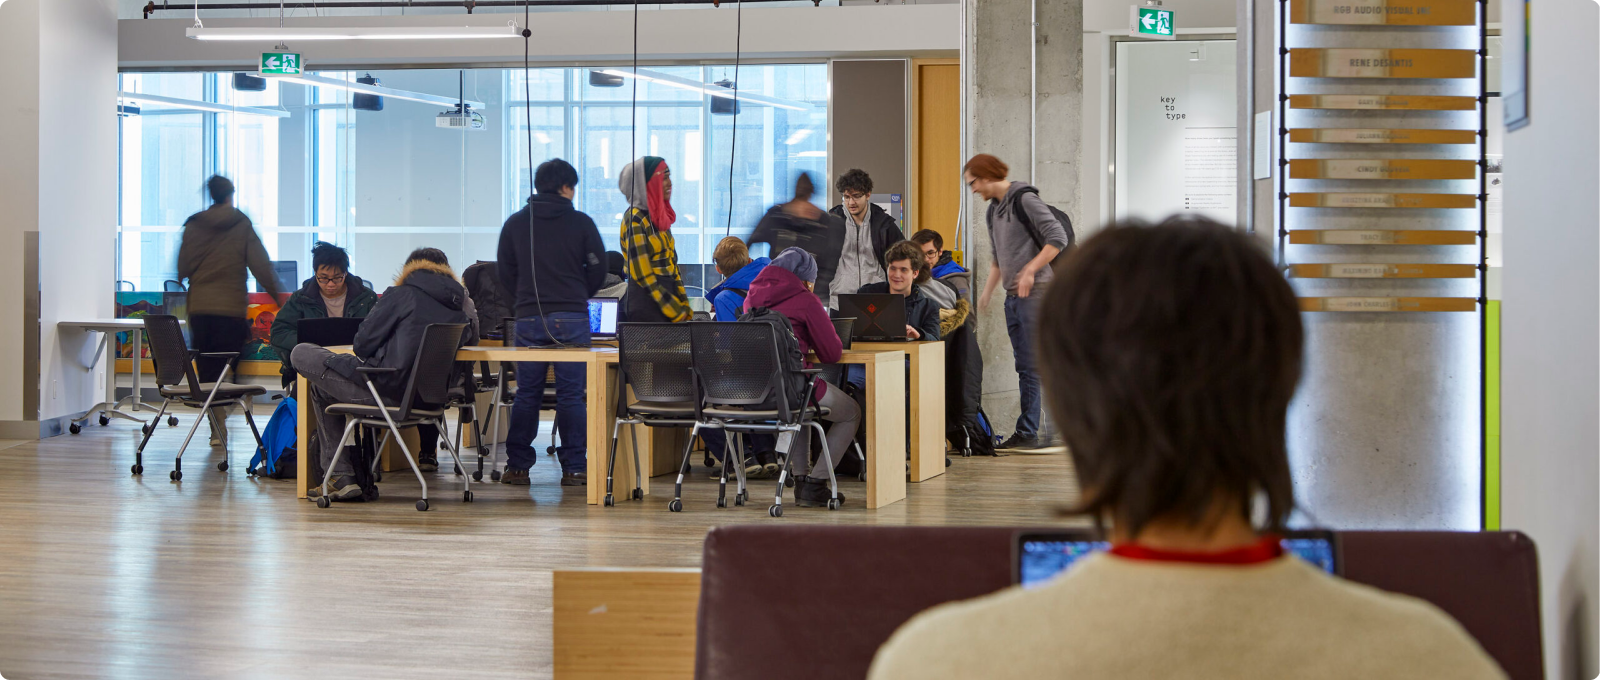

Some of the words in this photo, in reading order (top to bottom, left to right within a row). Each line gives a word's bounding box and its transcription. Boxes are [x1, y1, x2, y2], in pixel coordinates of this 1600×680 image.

[1333, 5, 1352, 14] RGB
[1354, 5, 1382, 14] AUDIO
[1385, 5, 1414, 15] VISUAL
[1349, 58, 1371, 67] RENE
[1373, 58, 1413, 67] DESANTIS
[1160, 96, 1176, 104] key
[1166, 112, 1186, 120] type
[1357, 165, 1378, 173] CINDY
